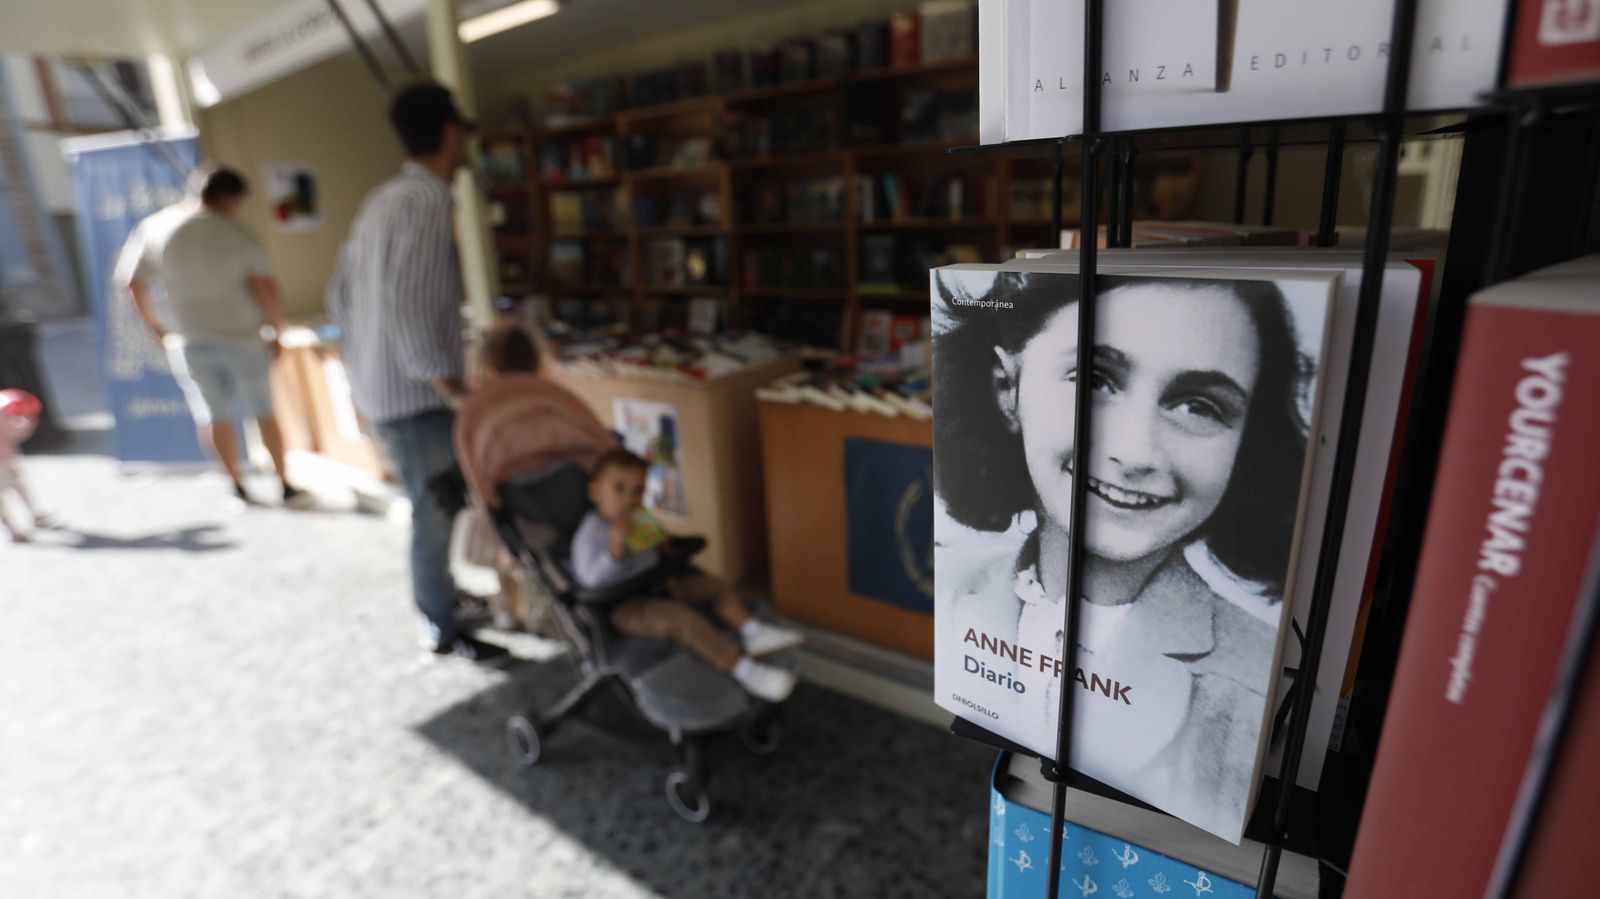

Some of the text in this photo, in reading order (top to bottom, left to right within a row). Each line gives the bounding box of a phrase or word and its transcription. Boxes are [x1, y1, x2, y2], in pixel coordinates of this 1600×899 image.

[1034, 34, 1472, 93] ALANZA EDITORAL
[951, 296, 1014, 310] Contemporánea
[1477, 351, 1570, 577] YOURCENAR
[963, 627, 1033, 668] ANNE
[963, 654, 1026, 695] Diario
[952, 693, 1000, 720] DEBOLSILLO
